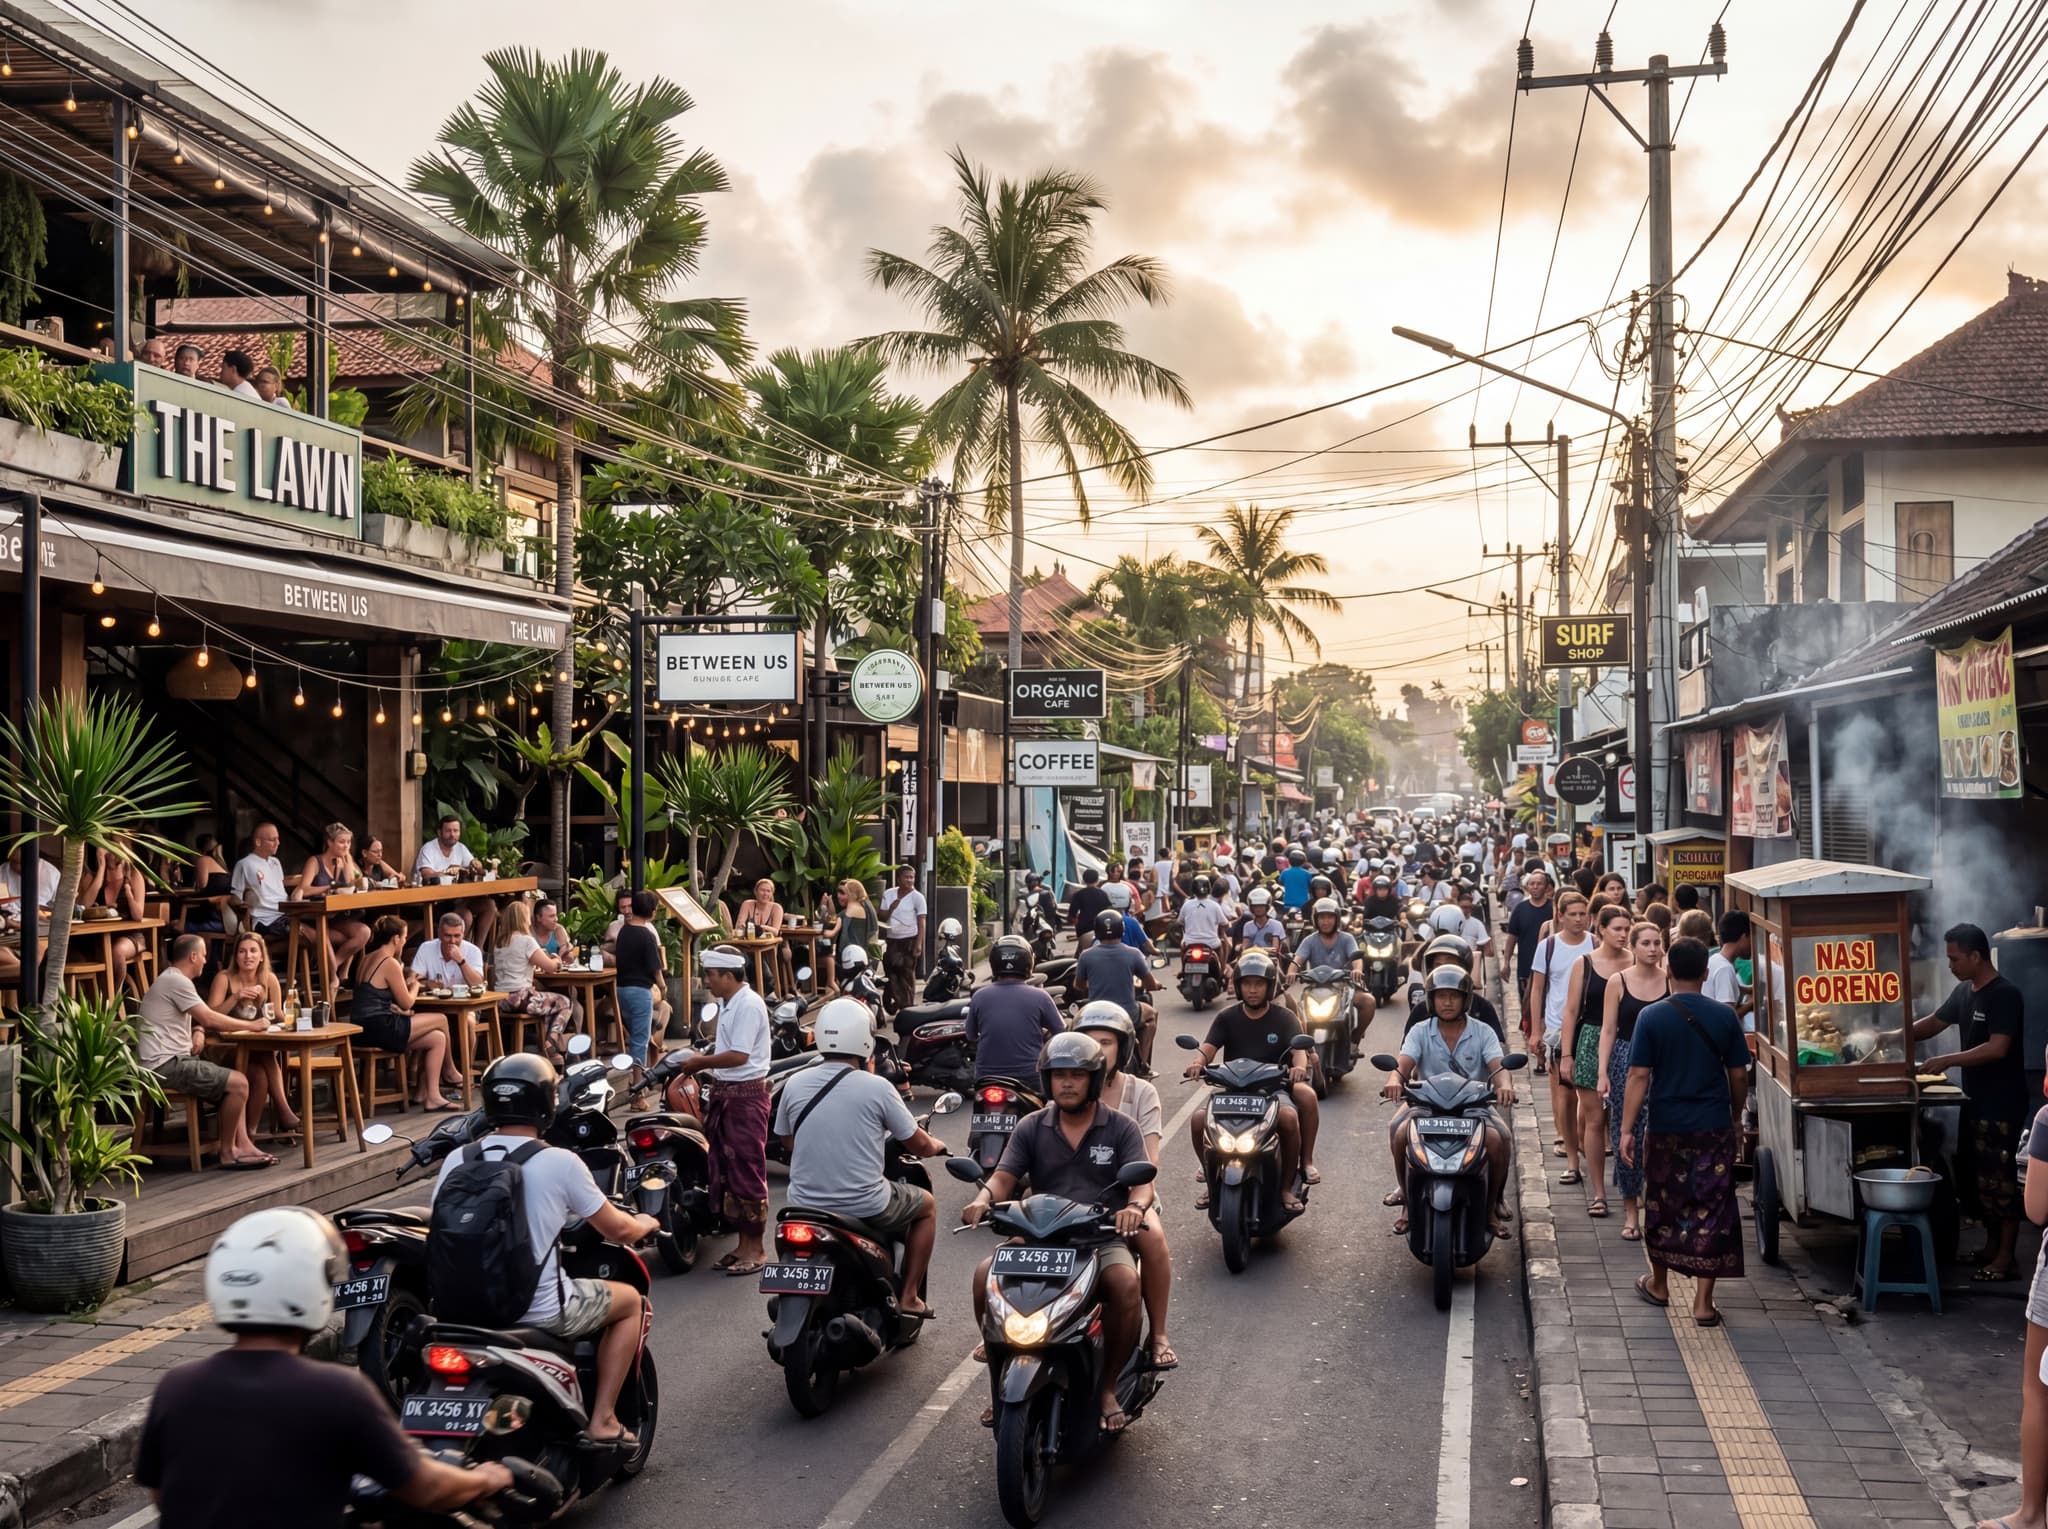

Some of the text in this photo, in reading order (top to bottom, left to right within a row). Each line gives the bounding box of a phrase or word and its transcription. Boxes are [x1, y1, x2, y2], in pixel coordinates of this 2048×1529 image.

[151, 399, 354, 519] THE LAWN
[284, 583, 368, 617] BETWEEN US
[510, 620, 556, 645] THE LAWN
[1556, 623, 1614, 646] SURF
[1568, 648, 1604, 660] SHOP
[667, 655, 788, 670] BETWEEN US
[1016, 684, 1098, 698] ORGANIC
[1044, 700, 1070, 708] CAFE
[1019, 754, 1094, 770] COFFEE
[1815, 940, 1875, 972] NASI
[1796, 972, 1900, 1005] GORENG
[998, 1250, 1072, 1263] DK 3456 XY
[764, 1266, 829, 1280] DK 3456 XY
[372, 1277, 386, 1291] XY
[405, 1400, 425, 1416] DK
[465, 1402, 486, 1418] XY
